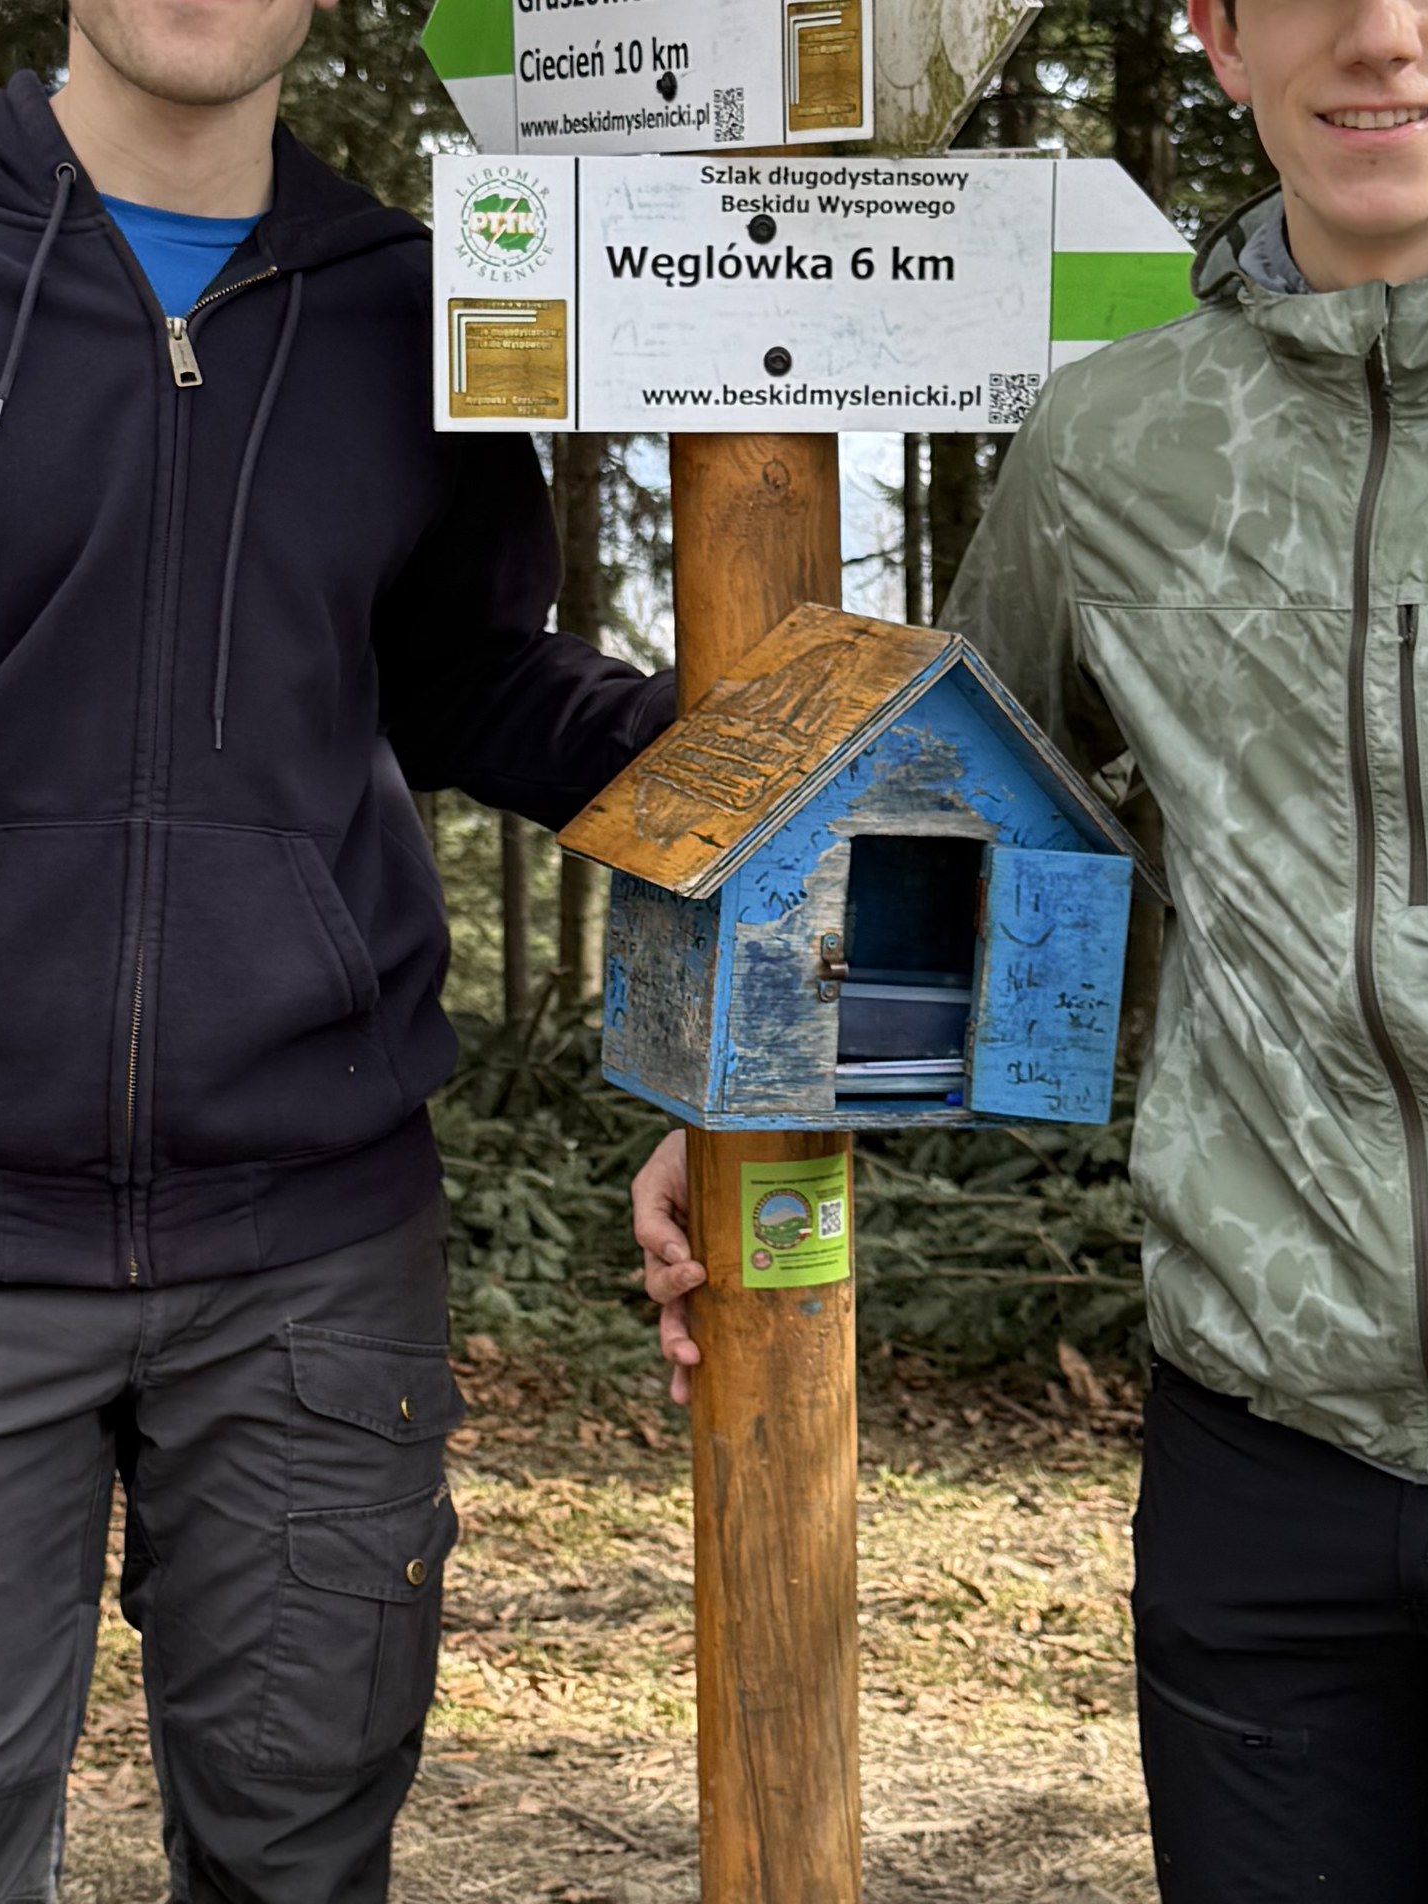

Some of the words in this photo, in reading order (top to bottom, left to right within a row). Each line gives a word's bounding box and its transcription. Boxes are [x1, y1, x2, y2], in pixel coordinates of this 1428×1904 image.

[520, 39, 605, 83] Ciecień
[614, 40, 644, 75] 10
[652, 36, 690, 72] km
[521, 102, 711, 139] www.beskidmyslenicki.pl
[455, 166, 551, 199] LUBOMIR
[700, 165, 761, 186] Szlak
[768, 165, 969, 191] długodystansowy
[721, 194, 810, 214] Beskidu
[817, 195, 956, 219] Wyspowego
[469, 211, 536, 235] PTTK
[606, 242, 834, 288] Węglówka
[850, 246, 875, 281] 6
[891, 245, 955, 281] km
[643, 383, 982, 411] www.beskidmyslenicki.pl
